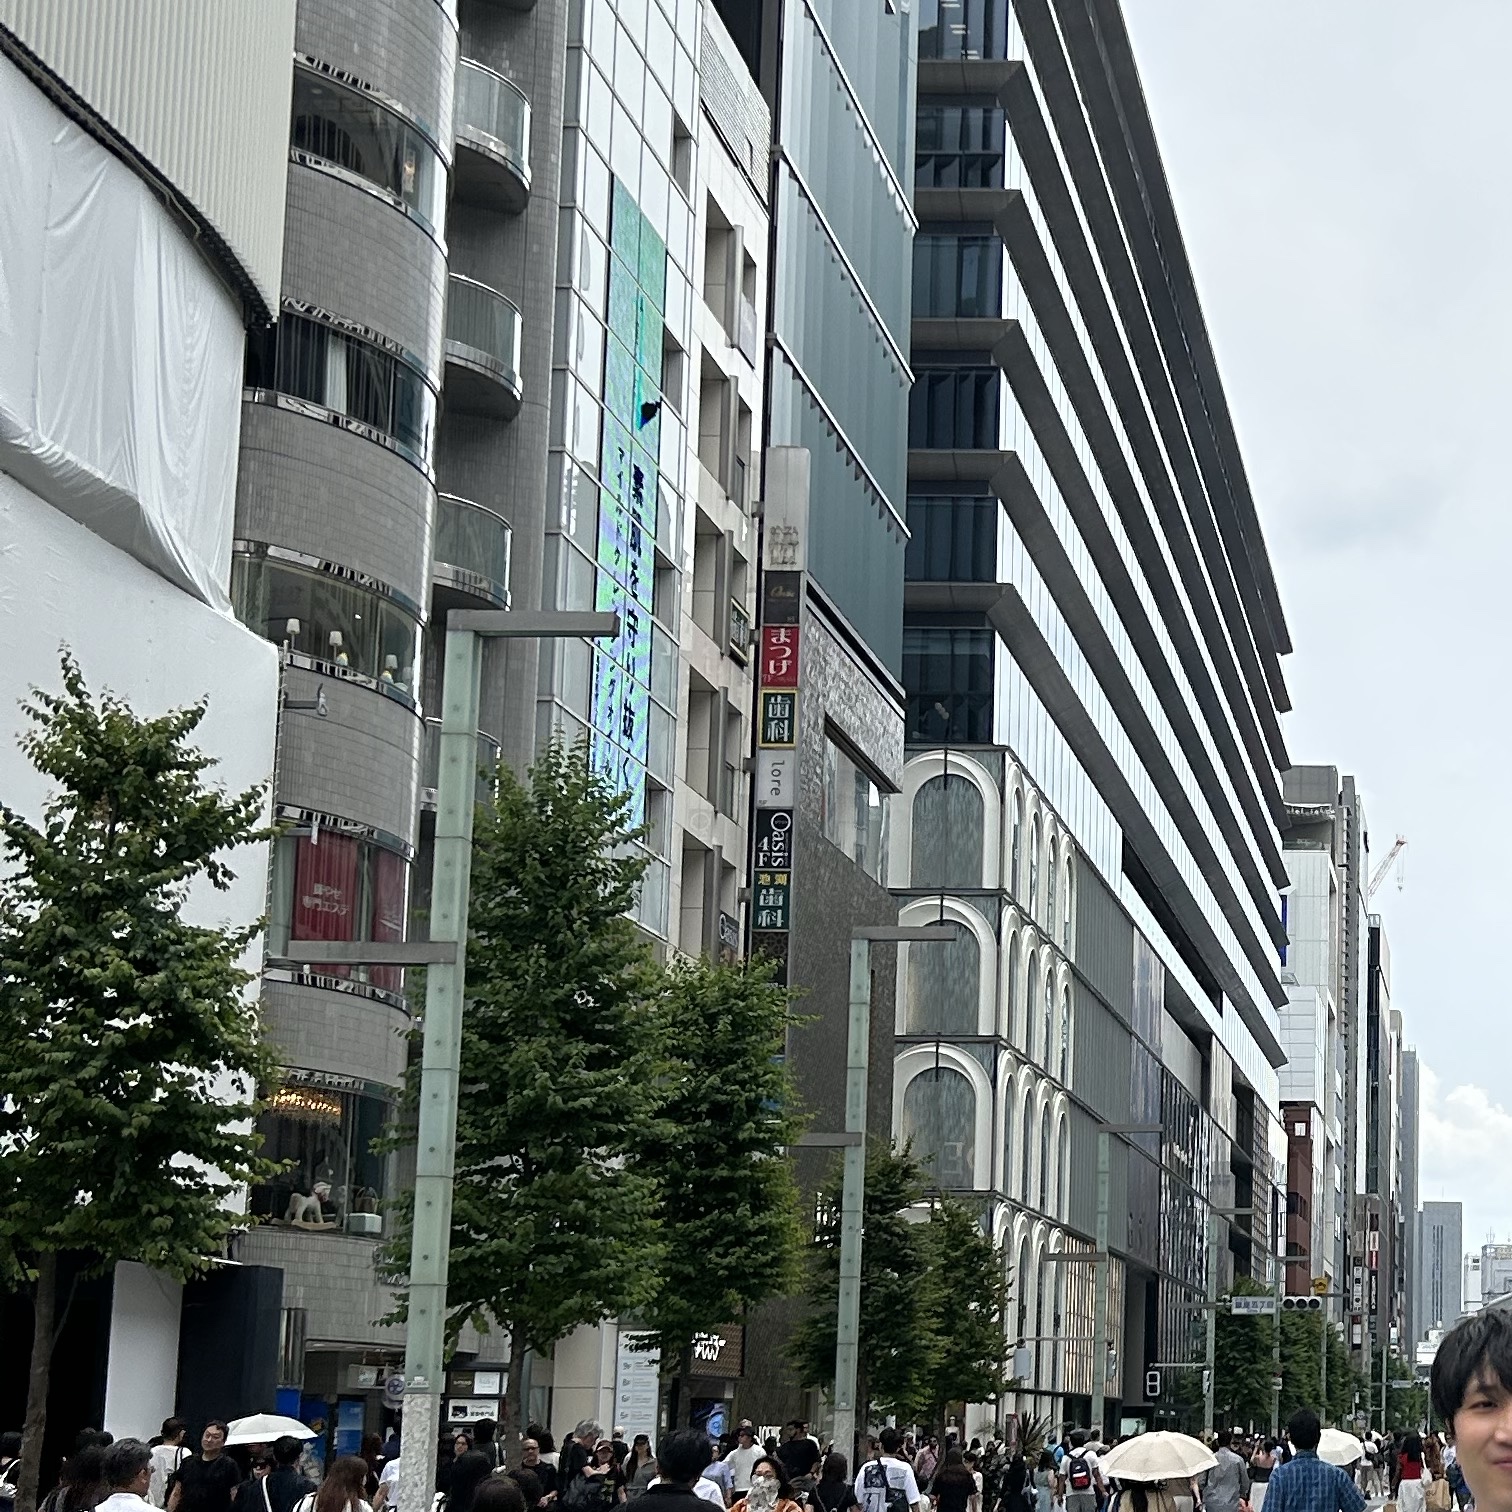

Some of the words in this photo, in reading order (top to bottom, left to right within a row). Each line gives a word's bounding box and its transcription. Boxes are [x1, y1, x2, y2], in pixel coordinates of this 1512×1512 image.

[768, 627, 792, 677] まつげ
[766, 694, 791, 743] 歯科
[770, 812, 792, 867] Oasis
